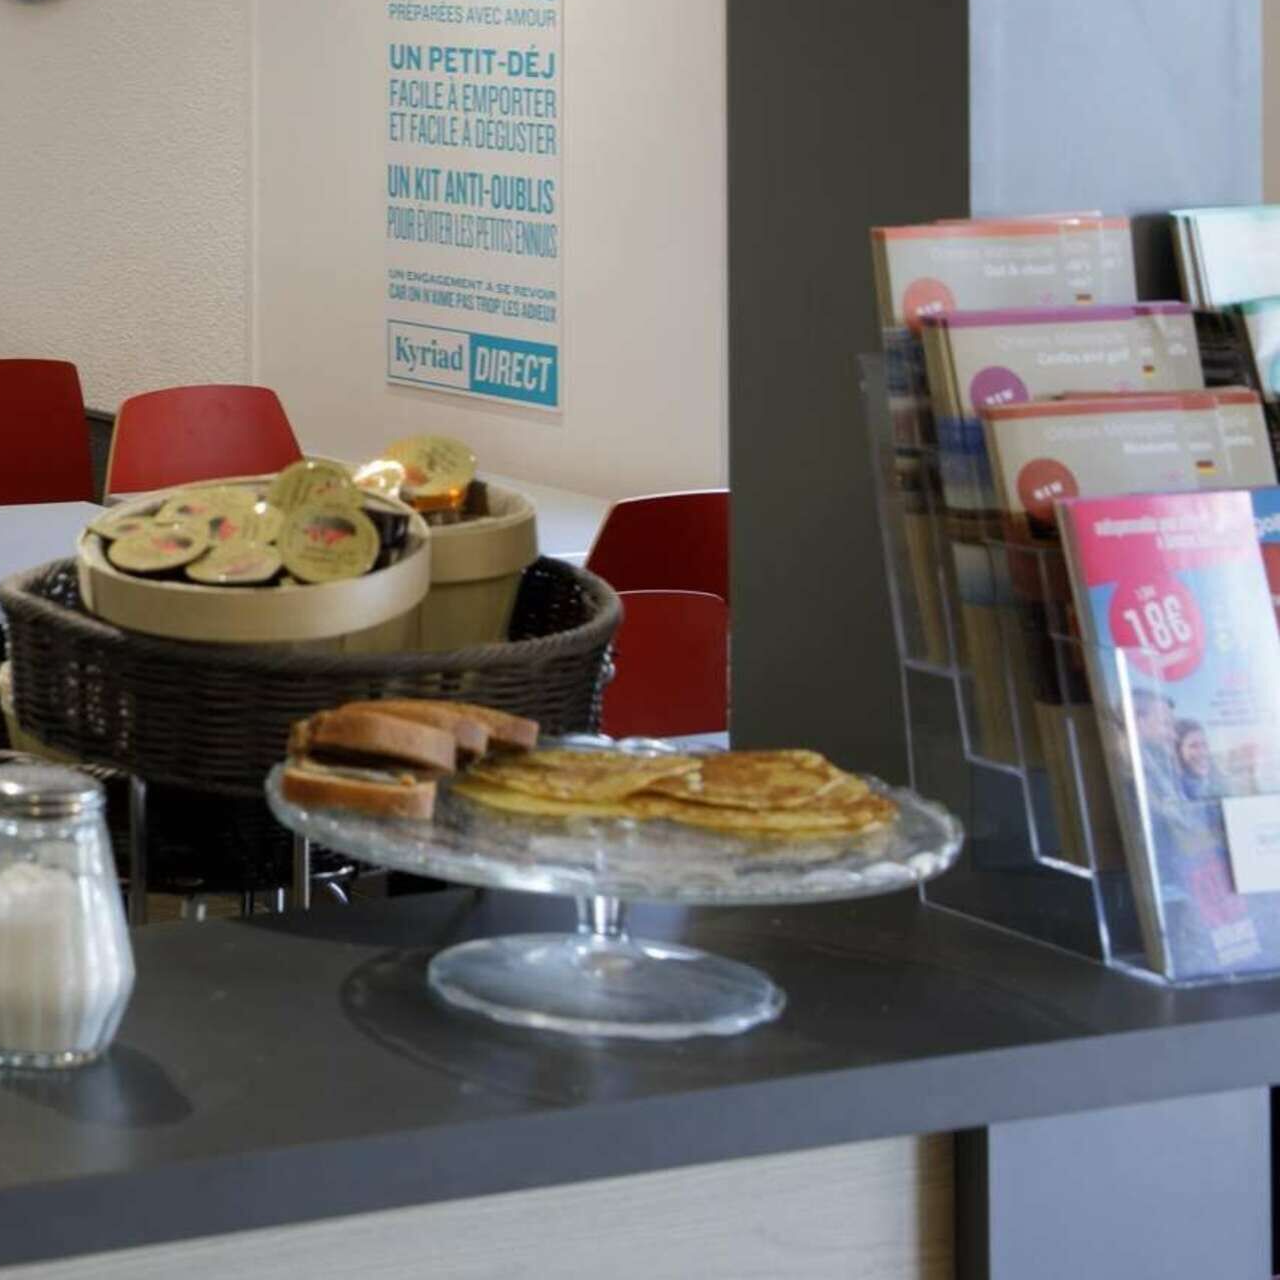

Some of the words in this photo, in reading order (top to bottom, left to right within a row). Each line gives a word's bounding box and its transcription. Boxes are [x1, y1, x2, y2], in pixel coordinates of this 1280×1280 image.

[466, 6, 501, 25] AVEC
[505, 8, 556, 27] AMOUR
[390, 44, 421, 70] UN
[429, 45, 555, 79] PETIT-DÉJ
[390, 79, 443, 110] FACILE
[448, 76, 458, 111] À
[463, 84, 557, 118] EMPORTER
[390, 112, 406, 141] ET
[410, 113, 459, 146] FACILE
[475, 114, 556, 155] DÉGUSTER
[388, 164, 410, 198] UN
[415, 167, 441, 201] KIT
[445, 170, 554, 214] ANTI-OUBLIS
[388, 206, 415, 240] POUR
[455, 213, 473, 248] LES
[477, 215, 512, 252] PETITS
[516, 220, 557, 258] ENNUIS
[407, 272, 482, 291] ENGAGEMENT
[396, 336, 463, 372] Kyriad
[474, 346, 553, 393] DIRECT
